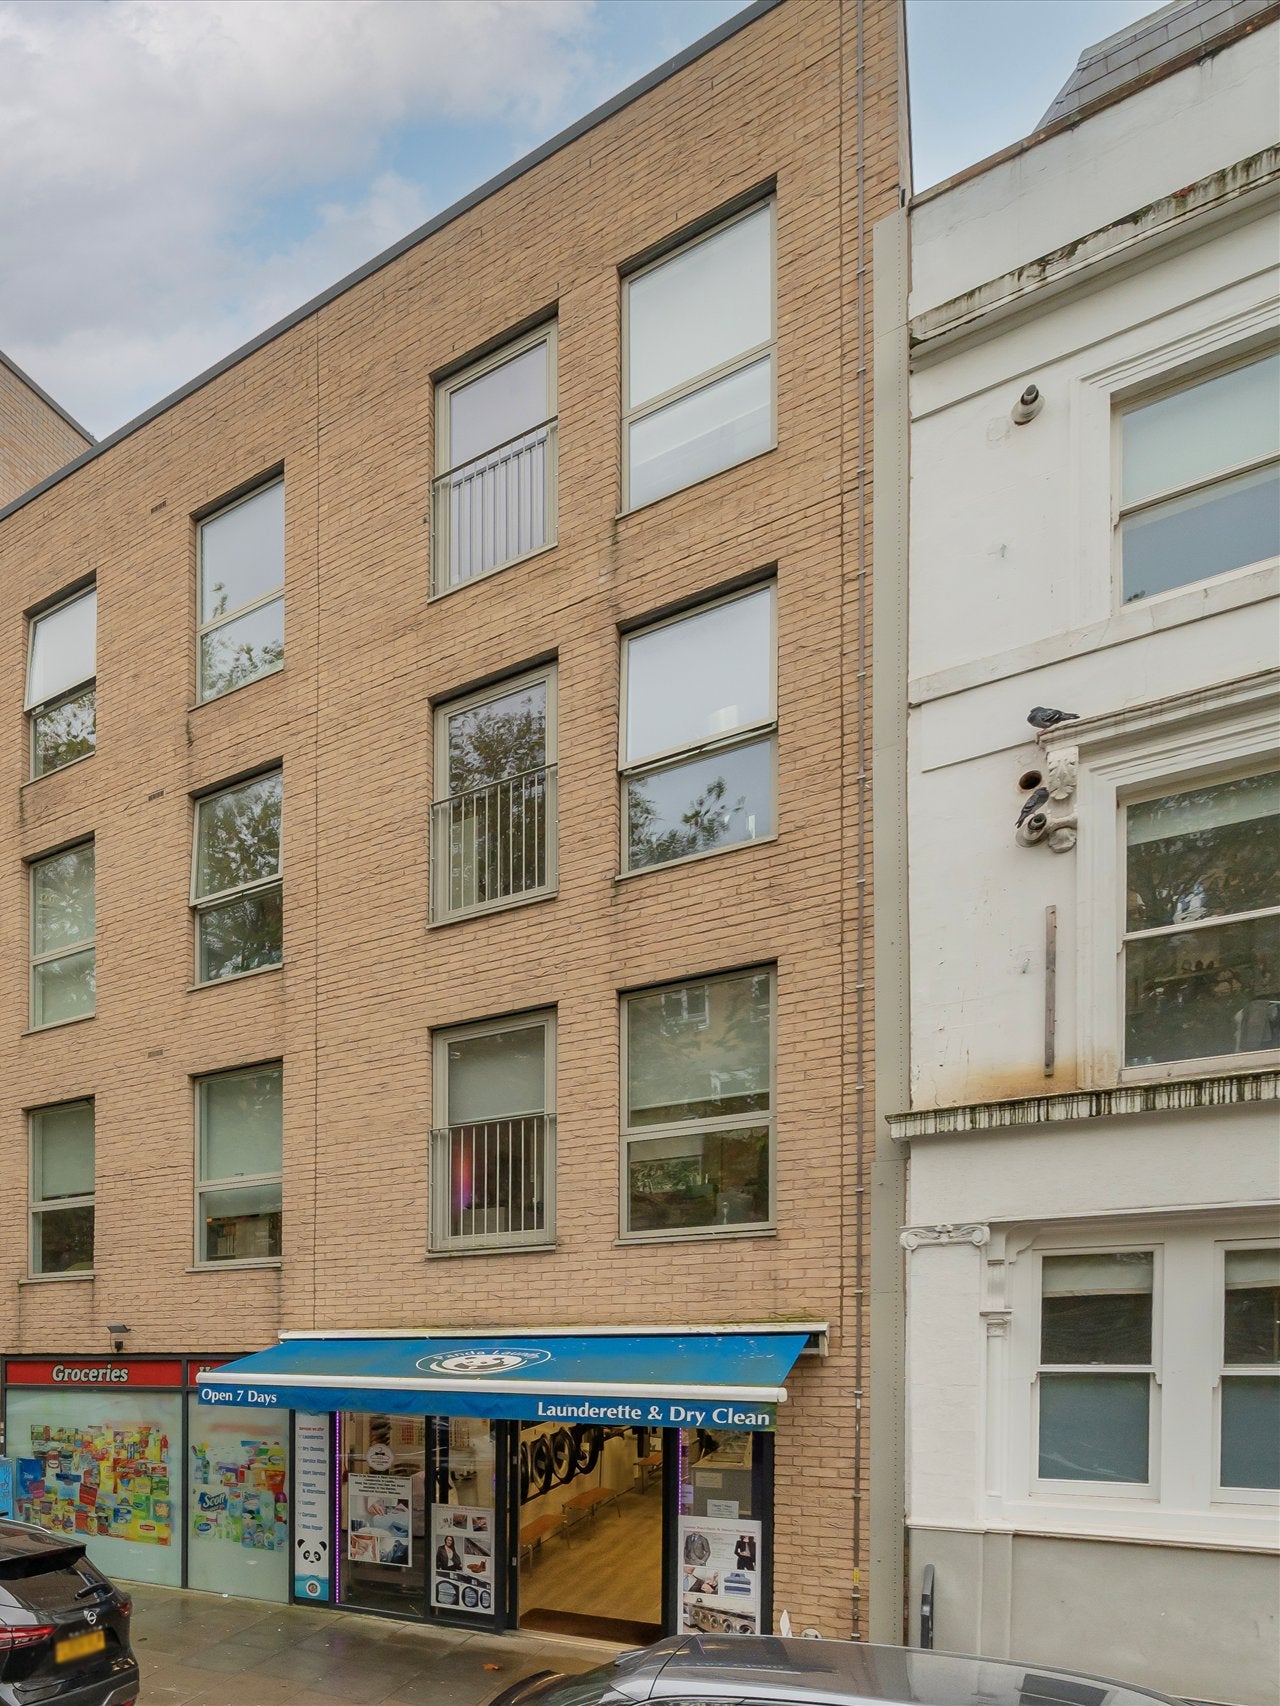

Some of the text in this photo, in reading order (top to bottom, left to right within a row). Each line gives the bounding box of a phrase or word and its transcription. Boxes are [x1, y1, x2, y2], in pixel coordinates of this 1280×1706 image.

[433, 1349, 486, 1360] Panda
[52, 1363, 129, 1382] Groceries
[201, 1388, 277, 1406] Open 7 Days
[537, 1401, 770, 1427] Launderette & Dry Clean
